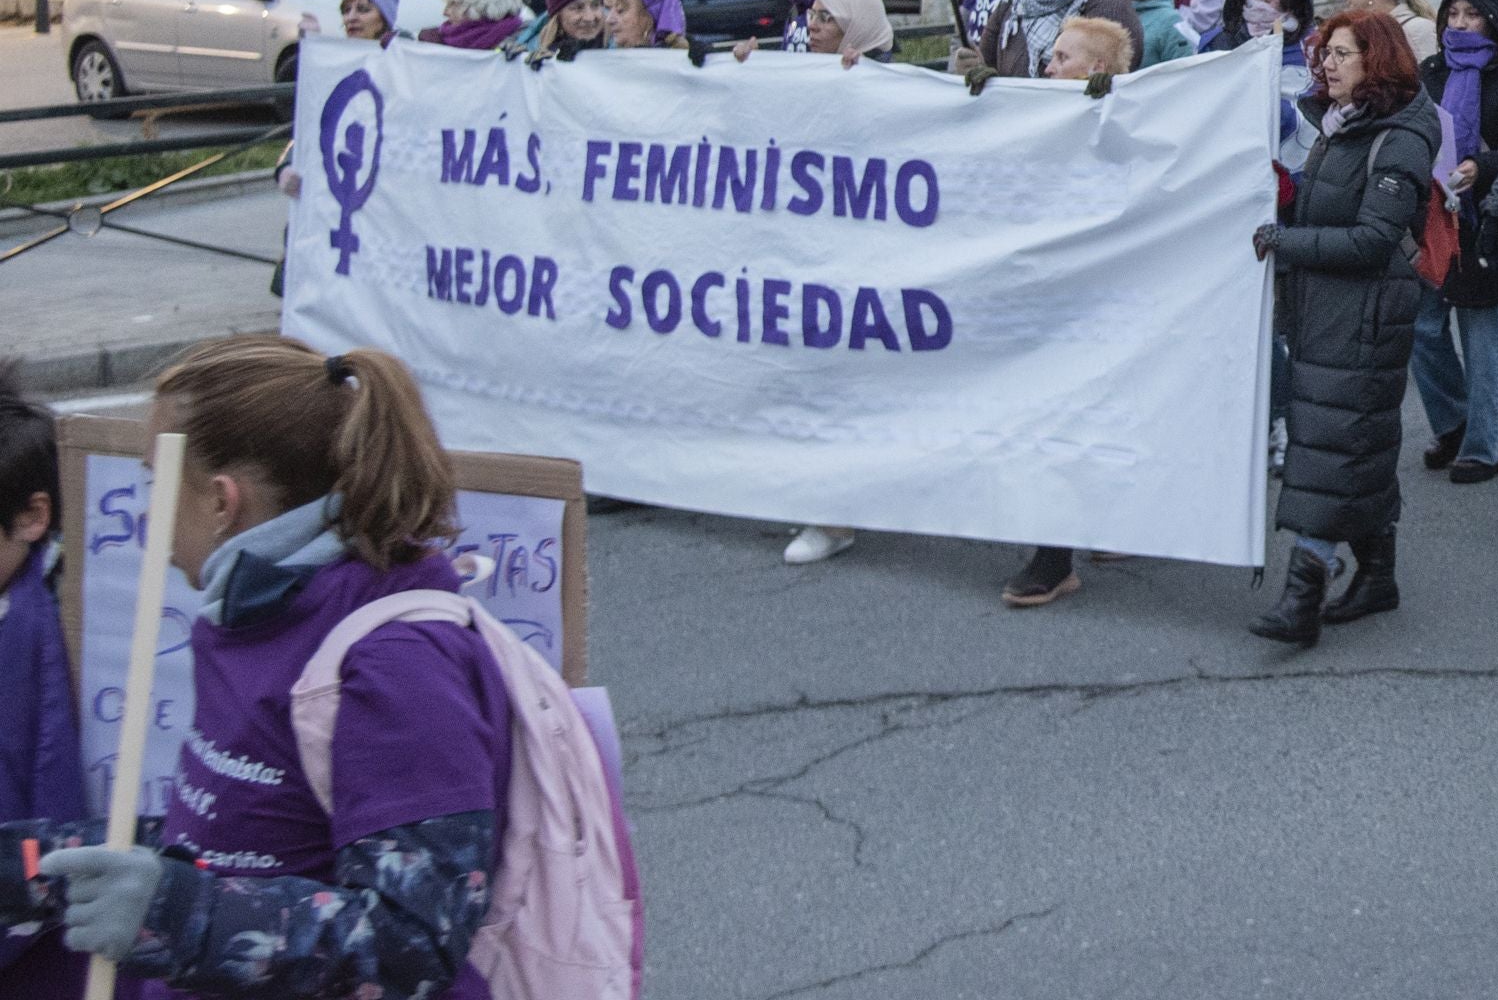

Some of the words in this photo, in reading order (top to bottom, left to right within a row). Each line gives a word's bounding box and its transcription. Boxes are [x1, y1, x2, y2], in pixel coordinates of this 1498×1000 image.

[582, 135, 940, 227] FEMINISMO
[425, 245, 558, 320] MEJOR
[605, 264, 954, 354] SOCIEDAD
